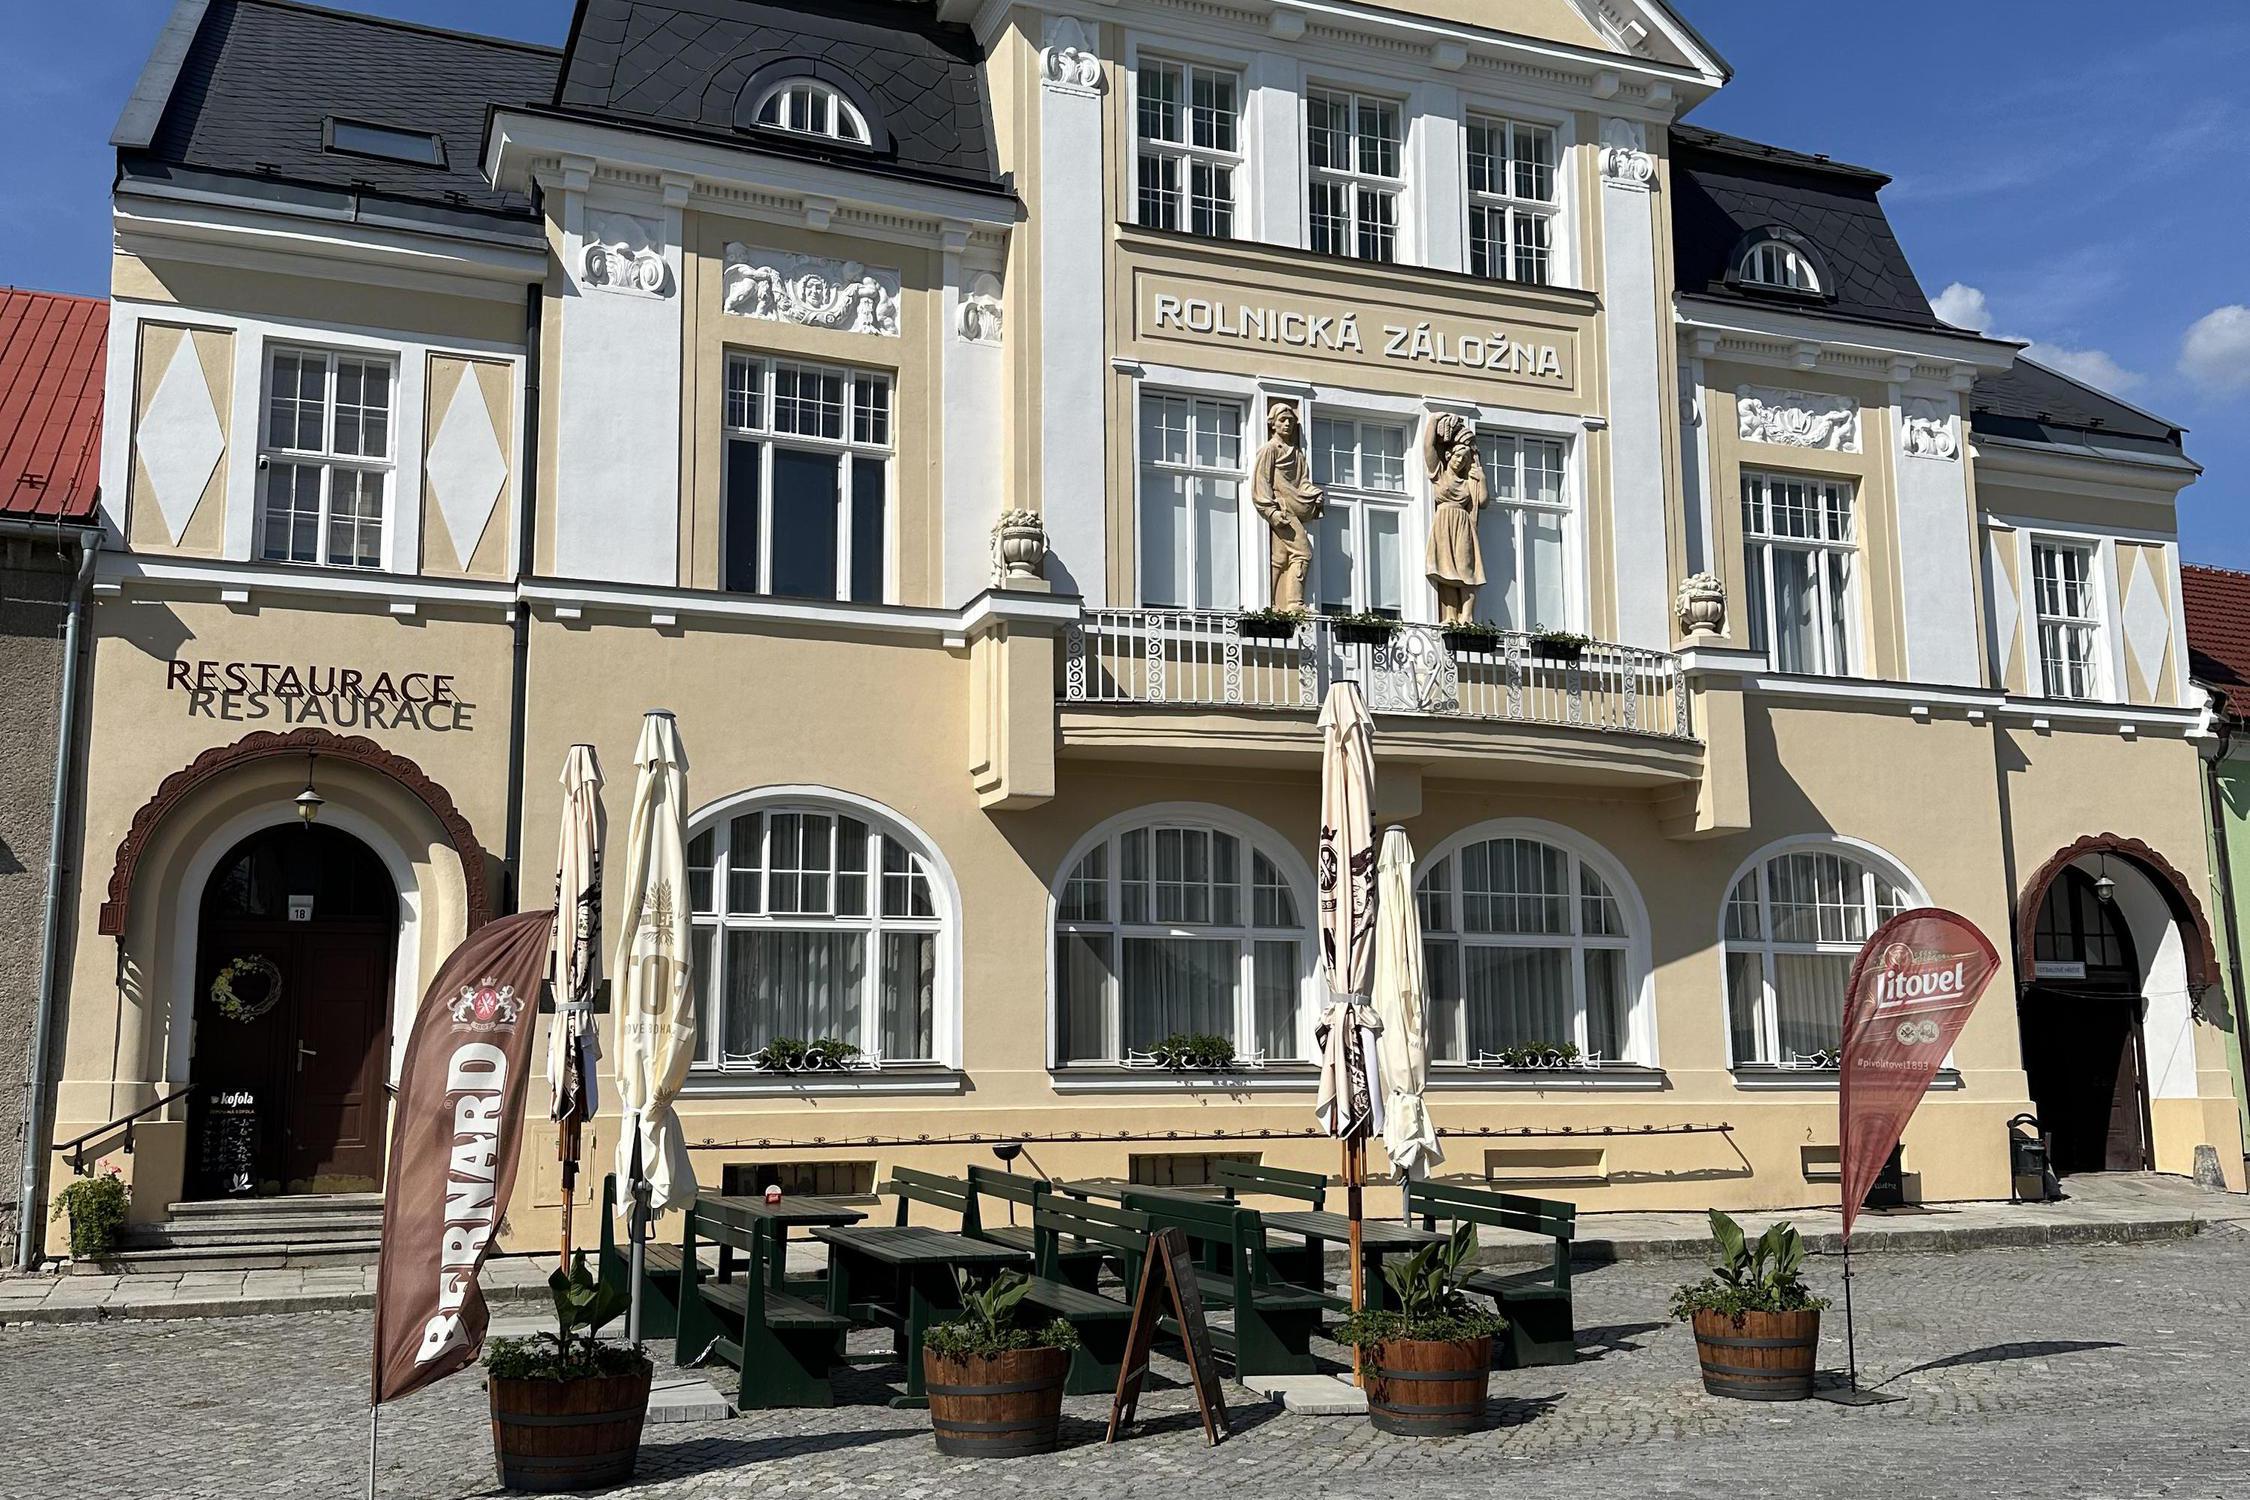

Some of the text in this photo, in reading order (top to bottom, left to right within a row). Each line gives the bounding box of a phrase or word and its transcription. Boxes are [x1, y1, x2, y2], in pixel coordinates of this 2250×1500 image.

[1154, 293, 1563, 378] ROLNICKÁ ZÁLOŽNA
[166, 659, 455, 703] RESTAURACE
[295, 908, 306, 919] 18
[1877, 961, 1965, 1009] Litovel
[221, 1091, 254, 1107] kofola
[414, 1042, 509, 1367] BERNARD
